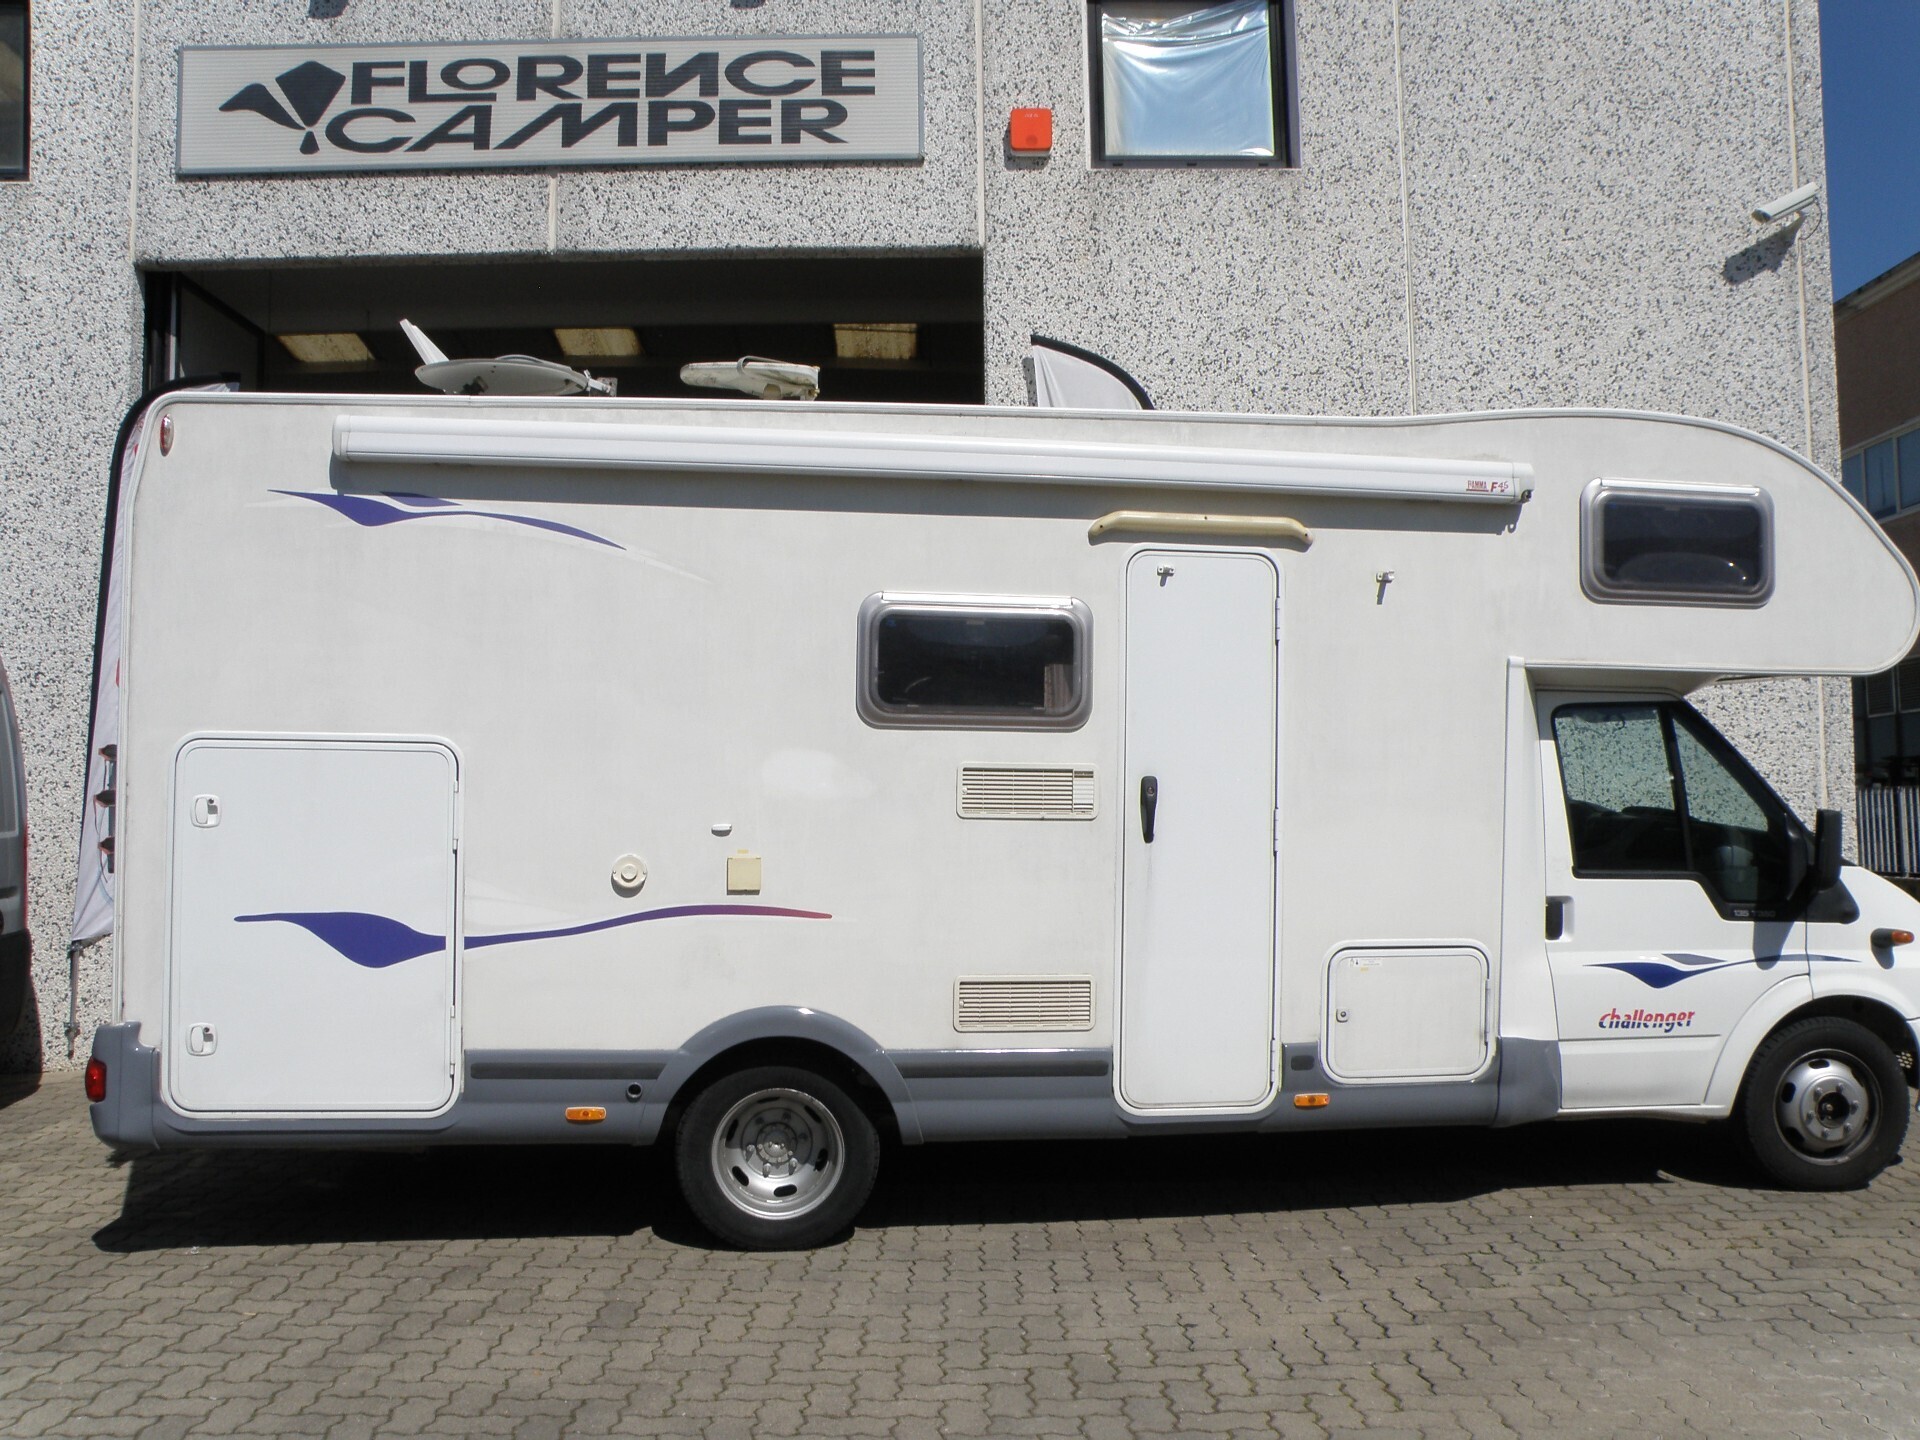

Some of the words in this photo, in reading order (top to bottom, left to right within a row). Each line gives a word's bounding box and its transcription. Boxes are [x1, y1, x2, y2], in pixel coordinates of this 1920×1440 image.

[351, 50, 876, 105] FLORENCE
[325, 98, 849, 153] CAMPER
[1598, 1008, 1695, 1033] challenger
